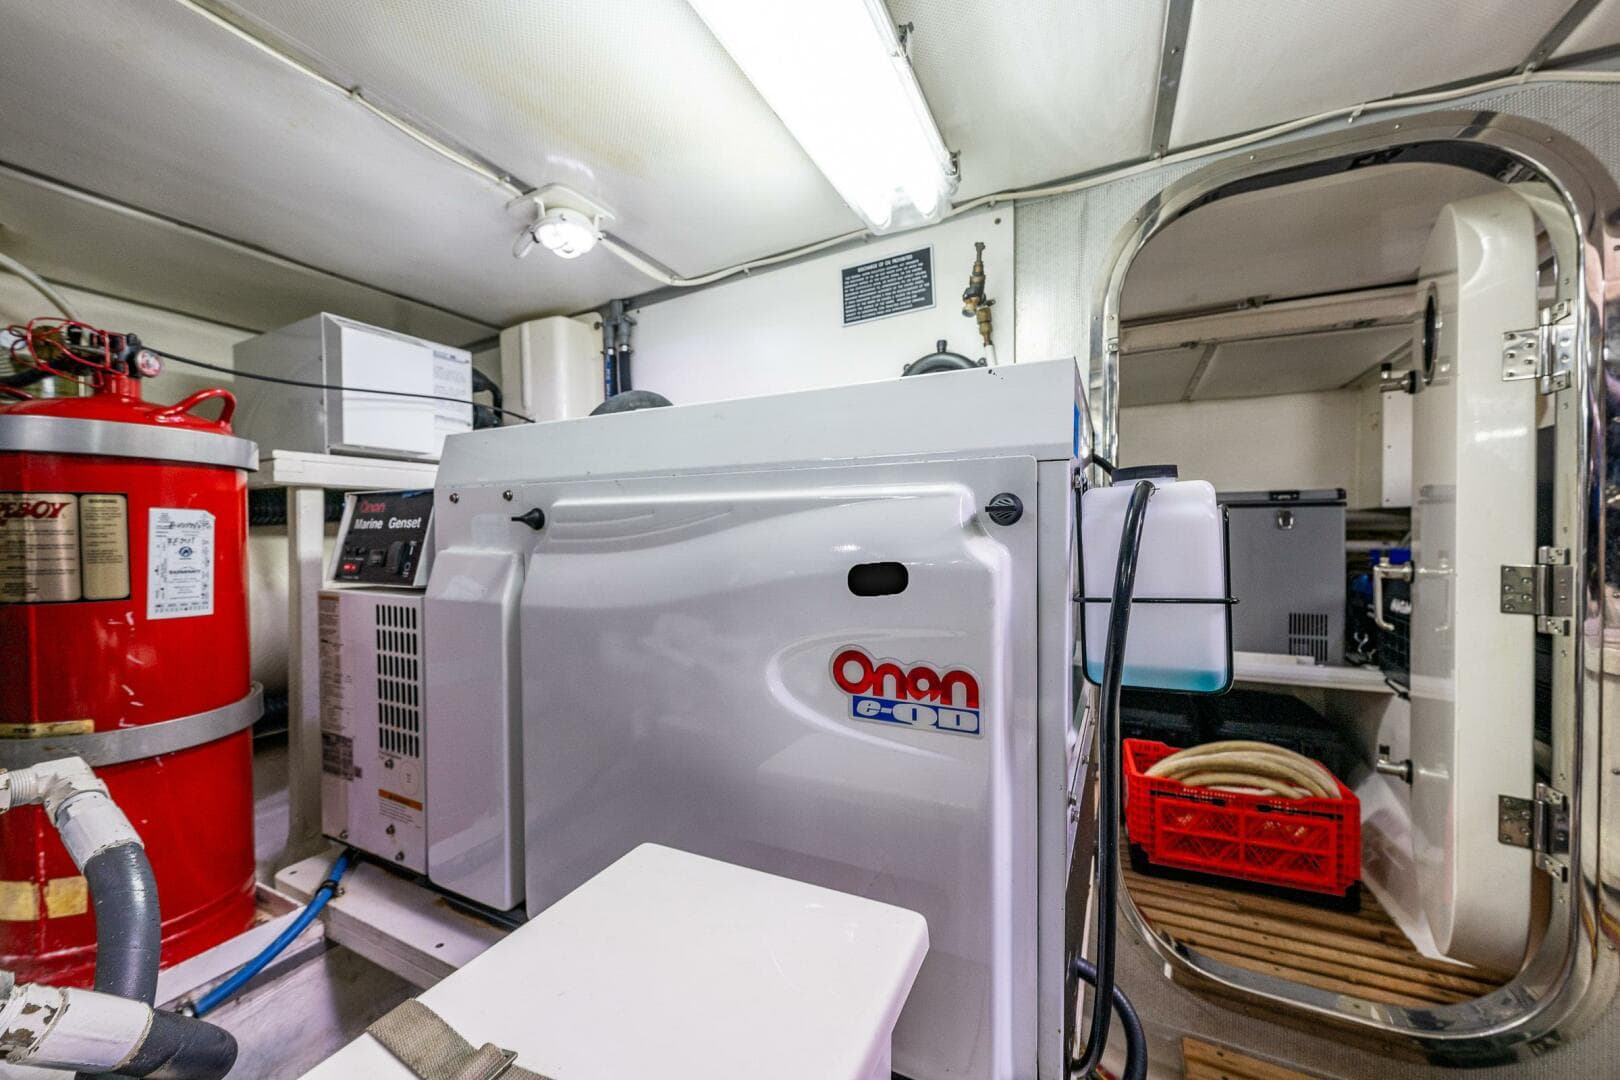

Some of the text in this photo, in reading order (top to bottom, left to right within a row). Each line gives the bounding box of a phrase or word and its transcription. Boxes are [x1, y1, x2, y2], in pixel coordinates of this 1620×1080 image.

[354, 517, 422, 530] Marine Genset
[833, 650, 979, 709] Onan
